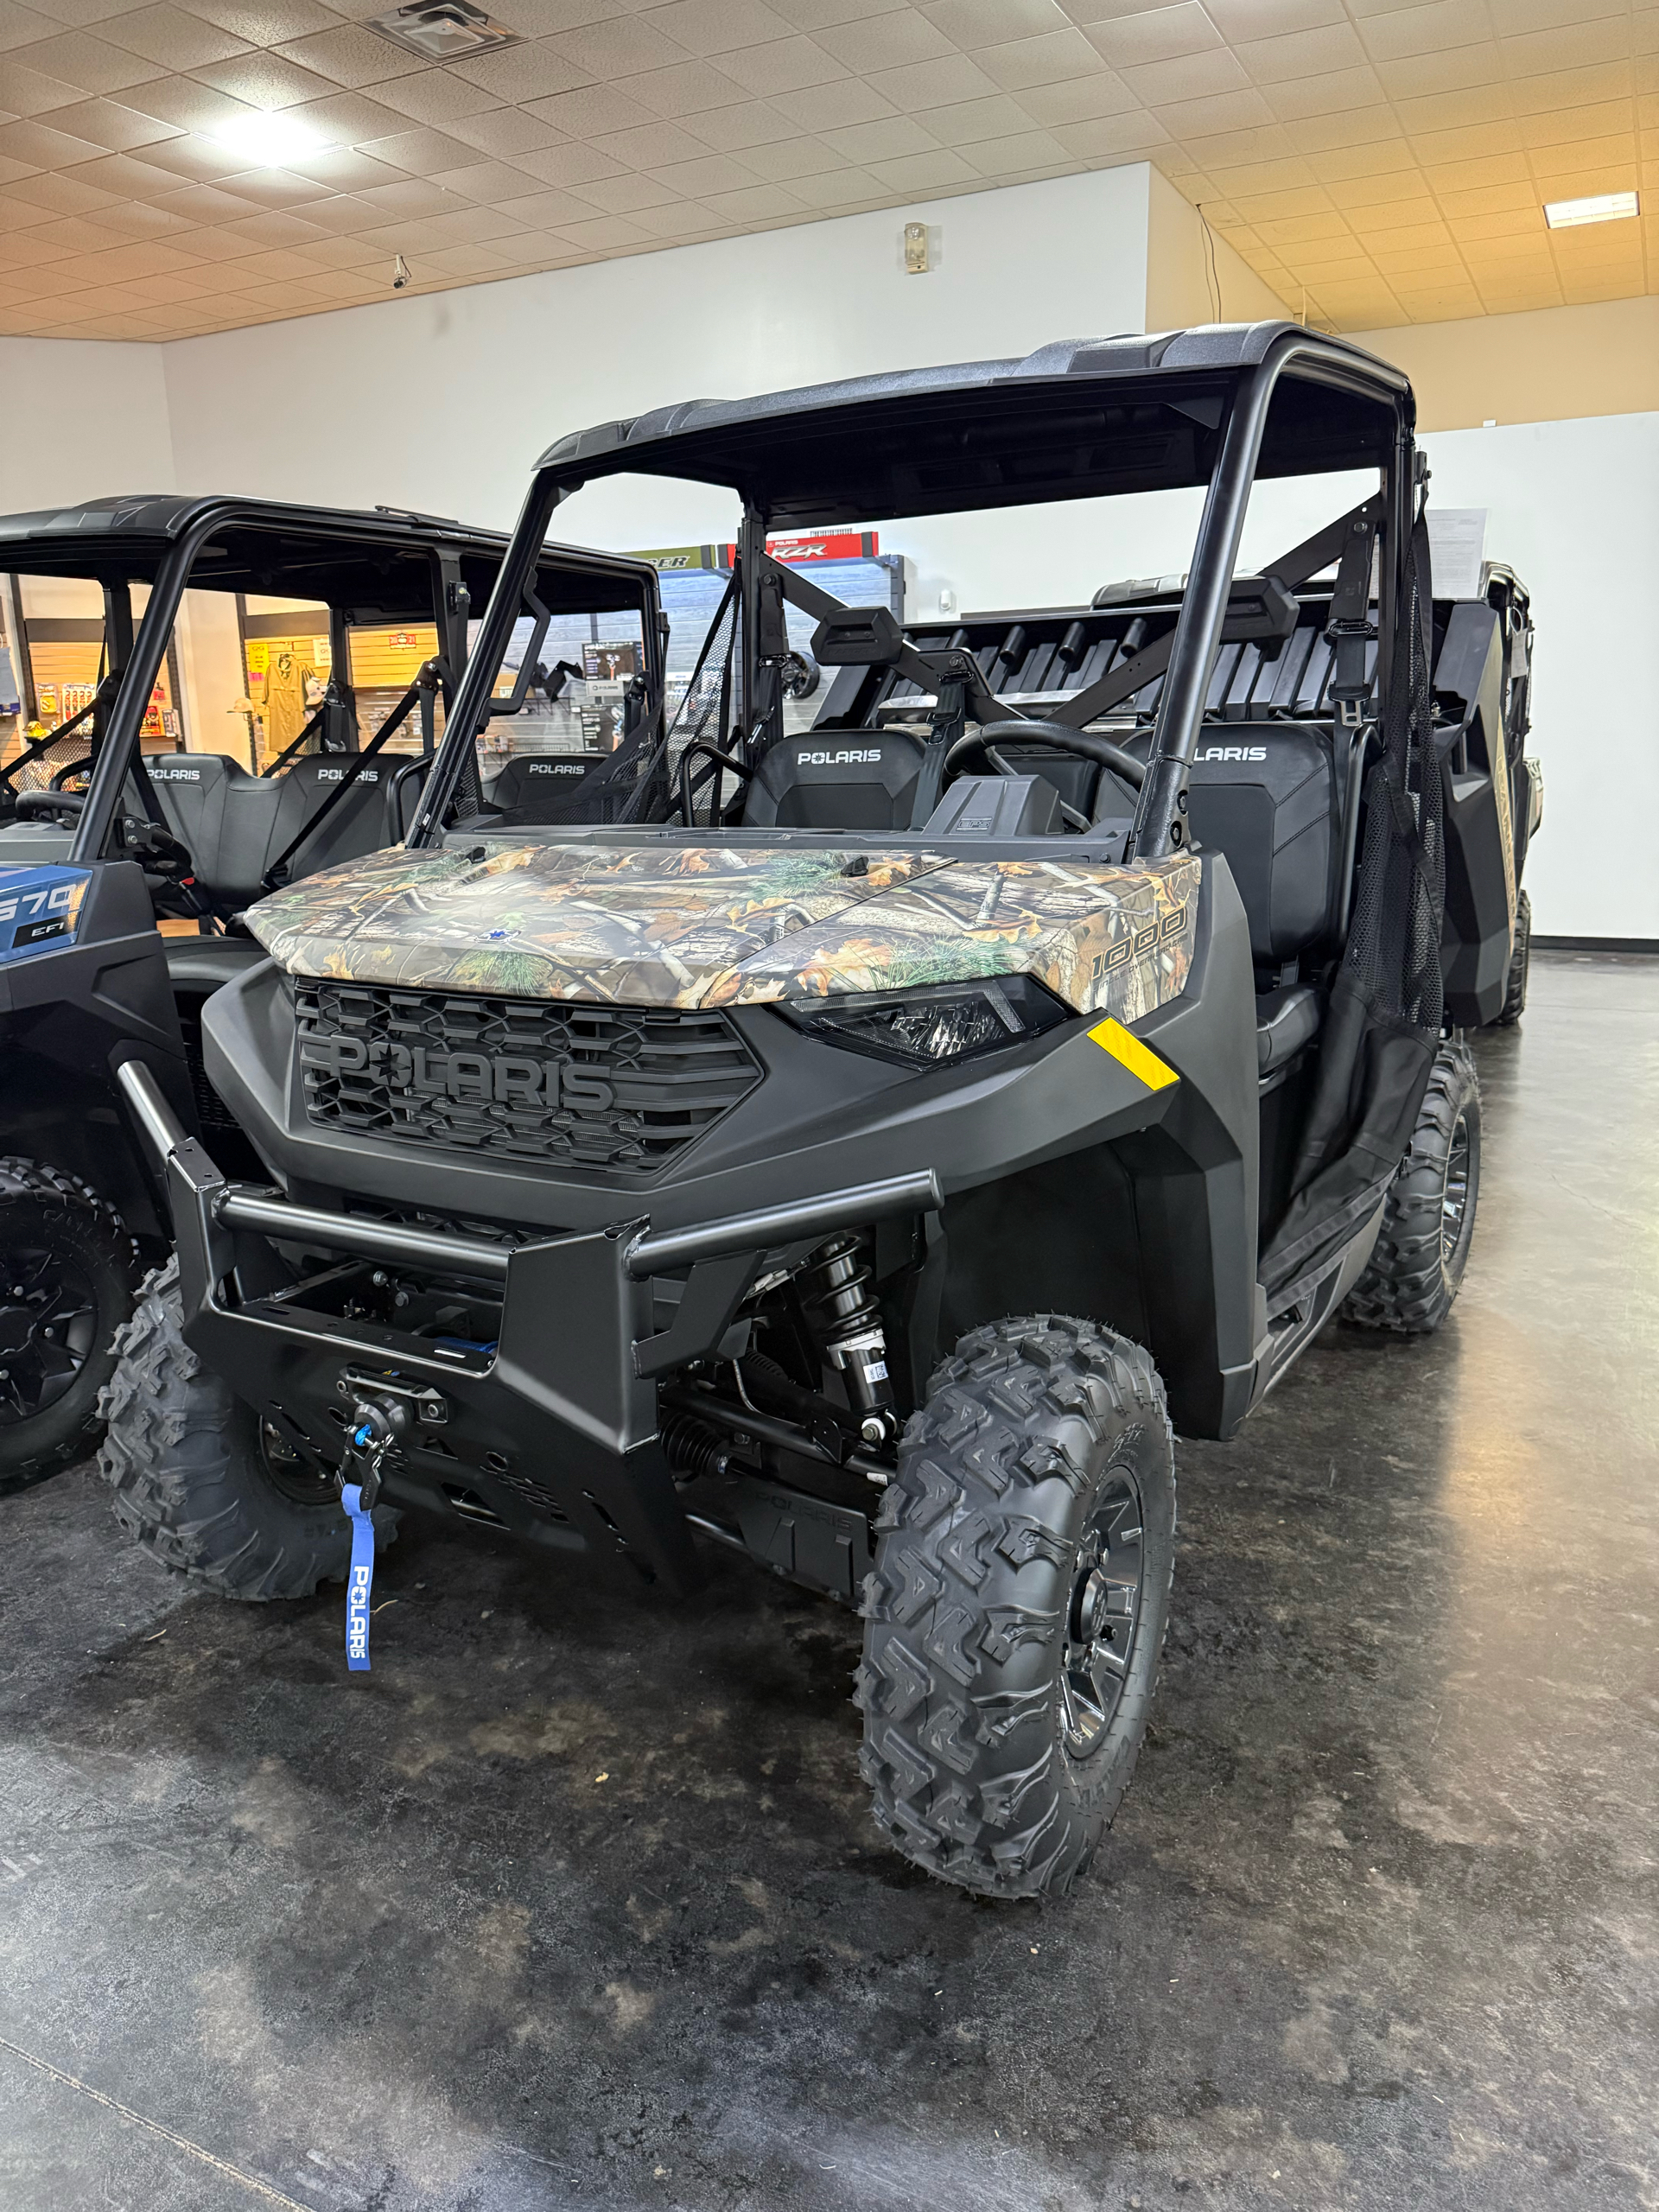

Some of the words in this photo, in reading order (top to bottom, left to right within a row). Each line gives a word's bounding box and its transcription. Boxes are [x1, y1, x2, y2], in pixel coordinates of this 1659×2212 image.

[772, 543, 827, 560] RZR
[648, 556, 688, 569] GER
[798, 749, 881, 765] POLARIS
[1193, 747, 1267, 761] LARIS
[147, 769, 200, 780] POLARIS
[317, 769, 378, 781] POLRIS
[529, 764, 585, 774] POLARIS
[31, 922, 65, 938] EFI
[1091, 906, 1188, 982] 1000
[330, 1034, 617, 1112] POLARIS
[350, 1566, 370, 1659] POLARIS
